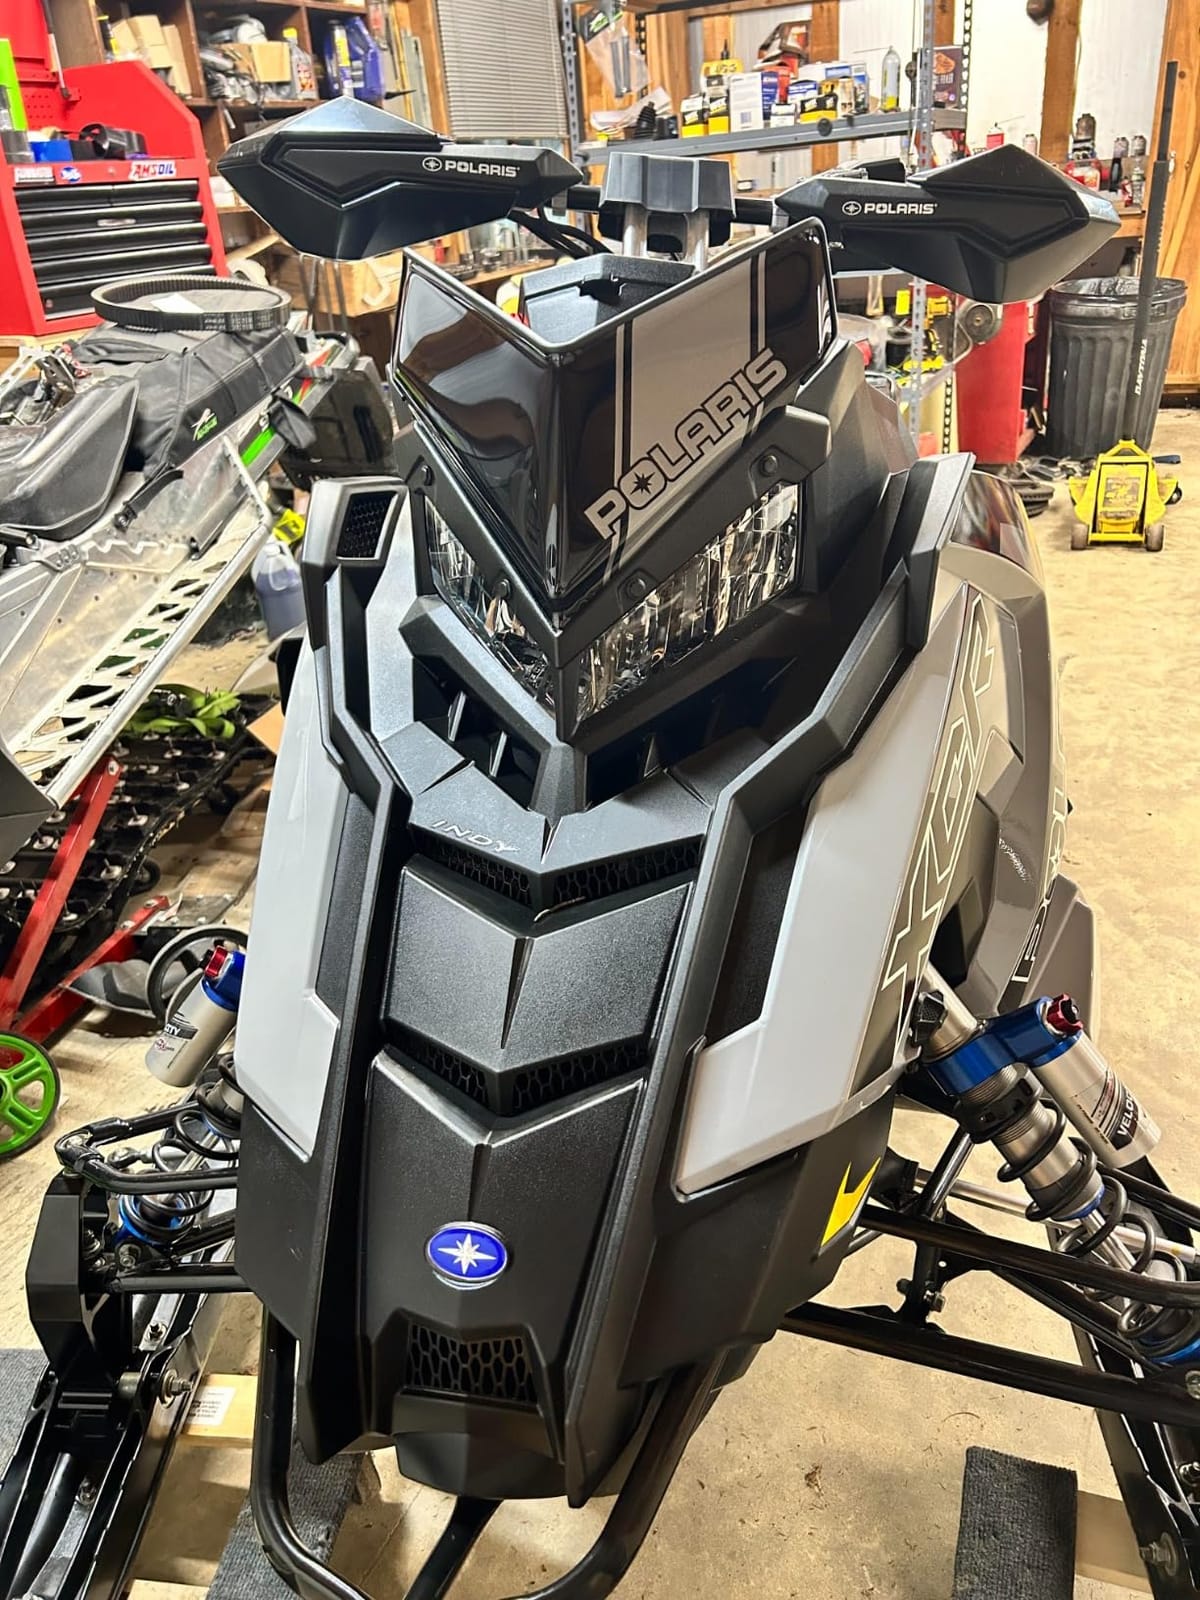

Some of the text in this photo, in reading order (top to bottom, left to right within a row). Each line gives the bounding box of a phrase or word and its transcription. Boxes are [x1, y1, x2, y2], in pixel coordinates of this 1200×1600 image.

[445, 160, 518, 177] POLARIS
[864, 203, 935, 215] POLARIS
[584, 347, 787, 540] POLARIS
[432, 820, 521, 853] INDY
